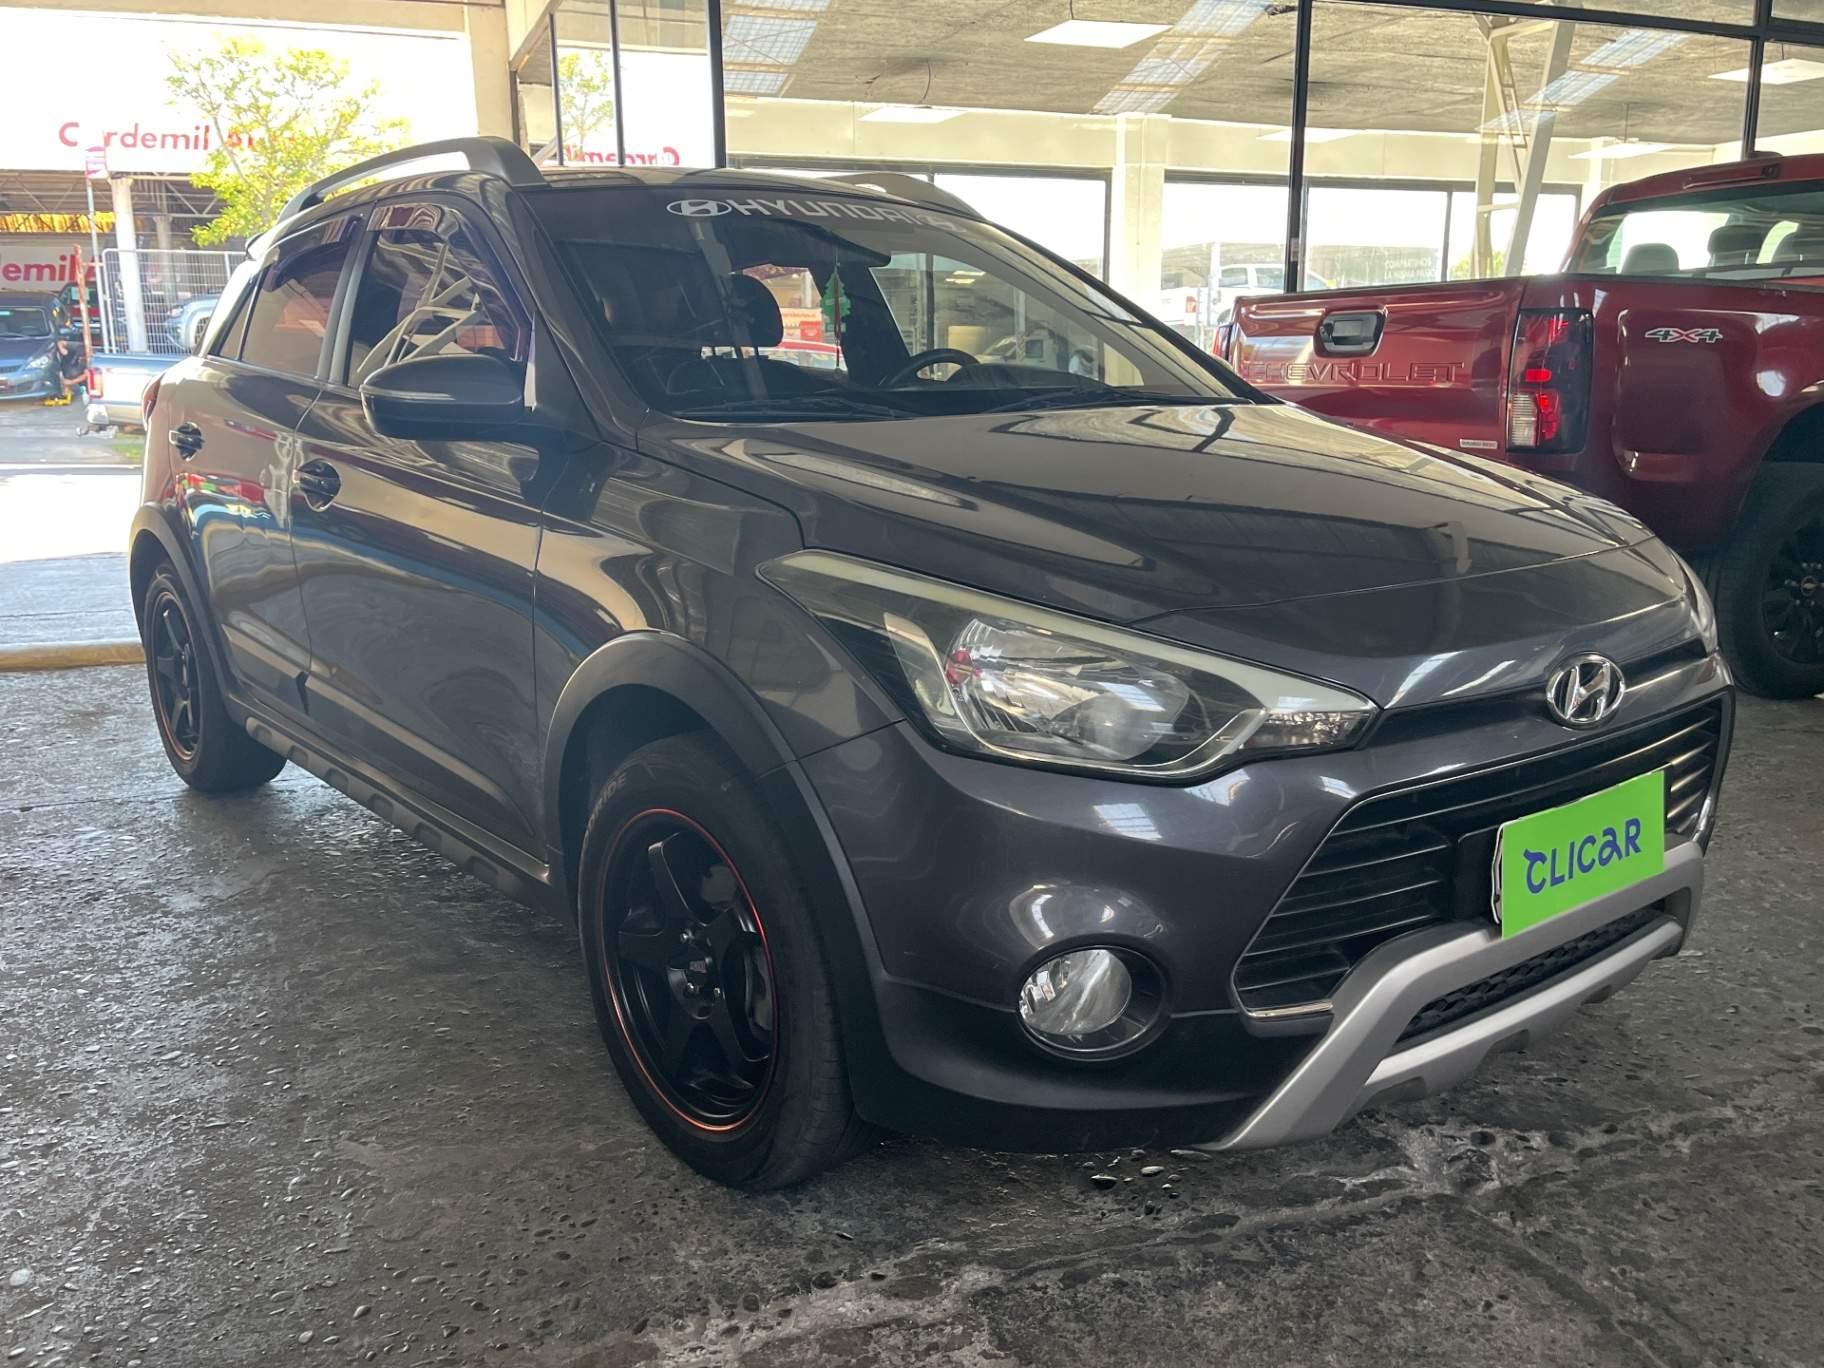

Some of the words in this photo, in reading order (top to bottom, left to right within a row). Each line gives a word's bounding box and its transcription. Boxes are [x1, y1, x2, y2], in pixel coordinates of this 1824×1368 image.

[58, 121, 210, 150] Crdemil
[724, 199, 923, 225] HYUNDAI
[1245, 360, 1465, 383] CHEVROLET
